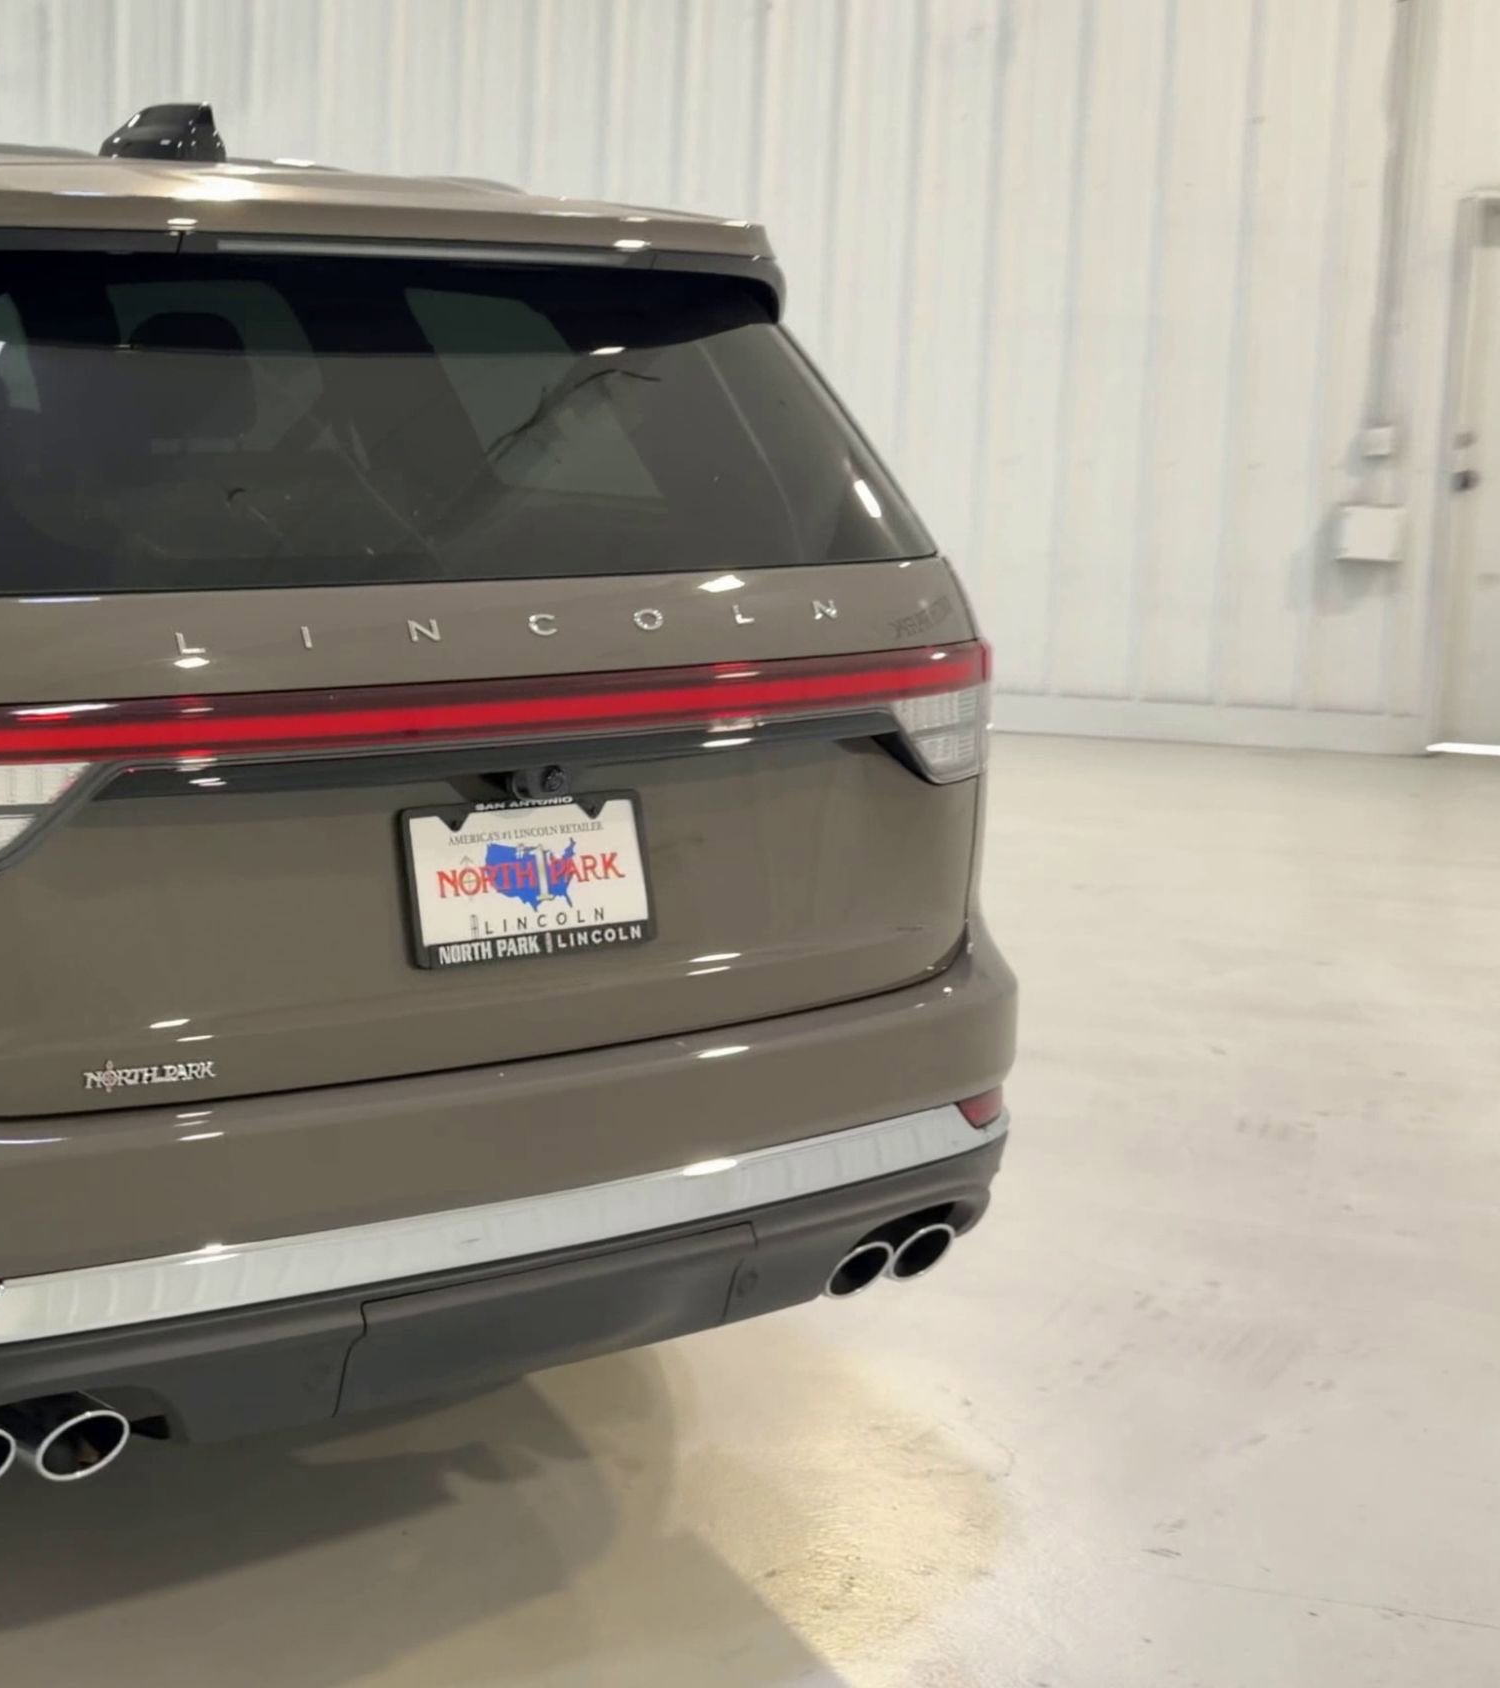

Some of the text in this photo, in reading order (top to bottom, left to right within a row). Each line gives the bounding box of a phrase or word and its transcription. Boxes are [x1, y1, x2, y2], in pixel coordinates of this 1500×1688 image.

[176, 600, 838, 655] LINCOLN
[475, 796, 573, 811] SAN ANTONIO
[448, 821, 604, 846] AMERICA'S #1 LINCOLN RETAILER
[436, 852, 625, 898] NORTH PARK
[485, 907, 605, 935] LINCOLN
[439, 924, 642, 965] NORTH PARK LINCOLN
[84, 1061, 217, 1090] NORTH PARK
